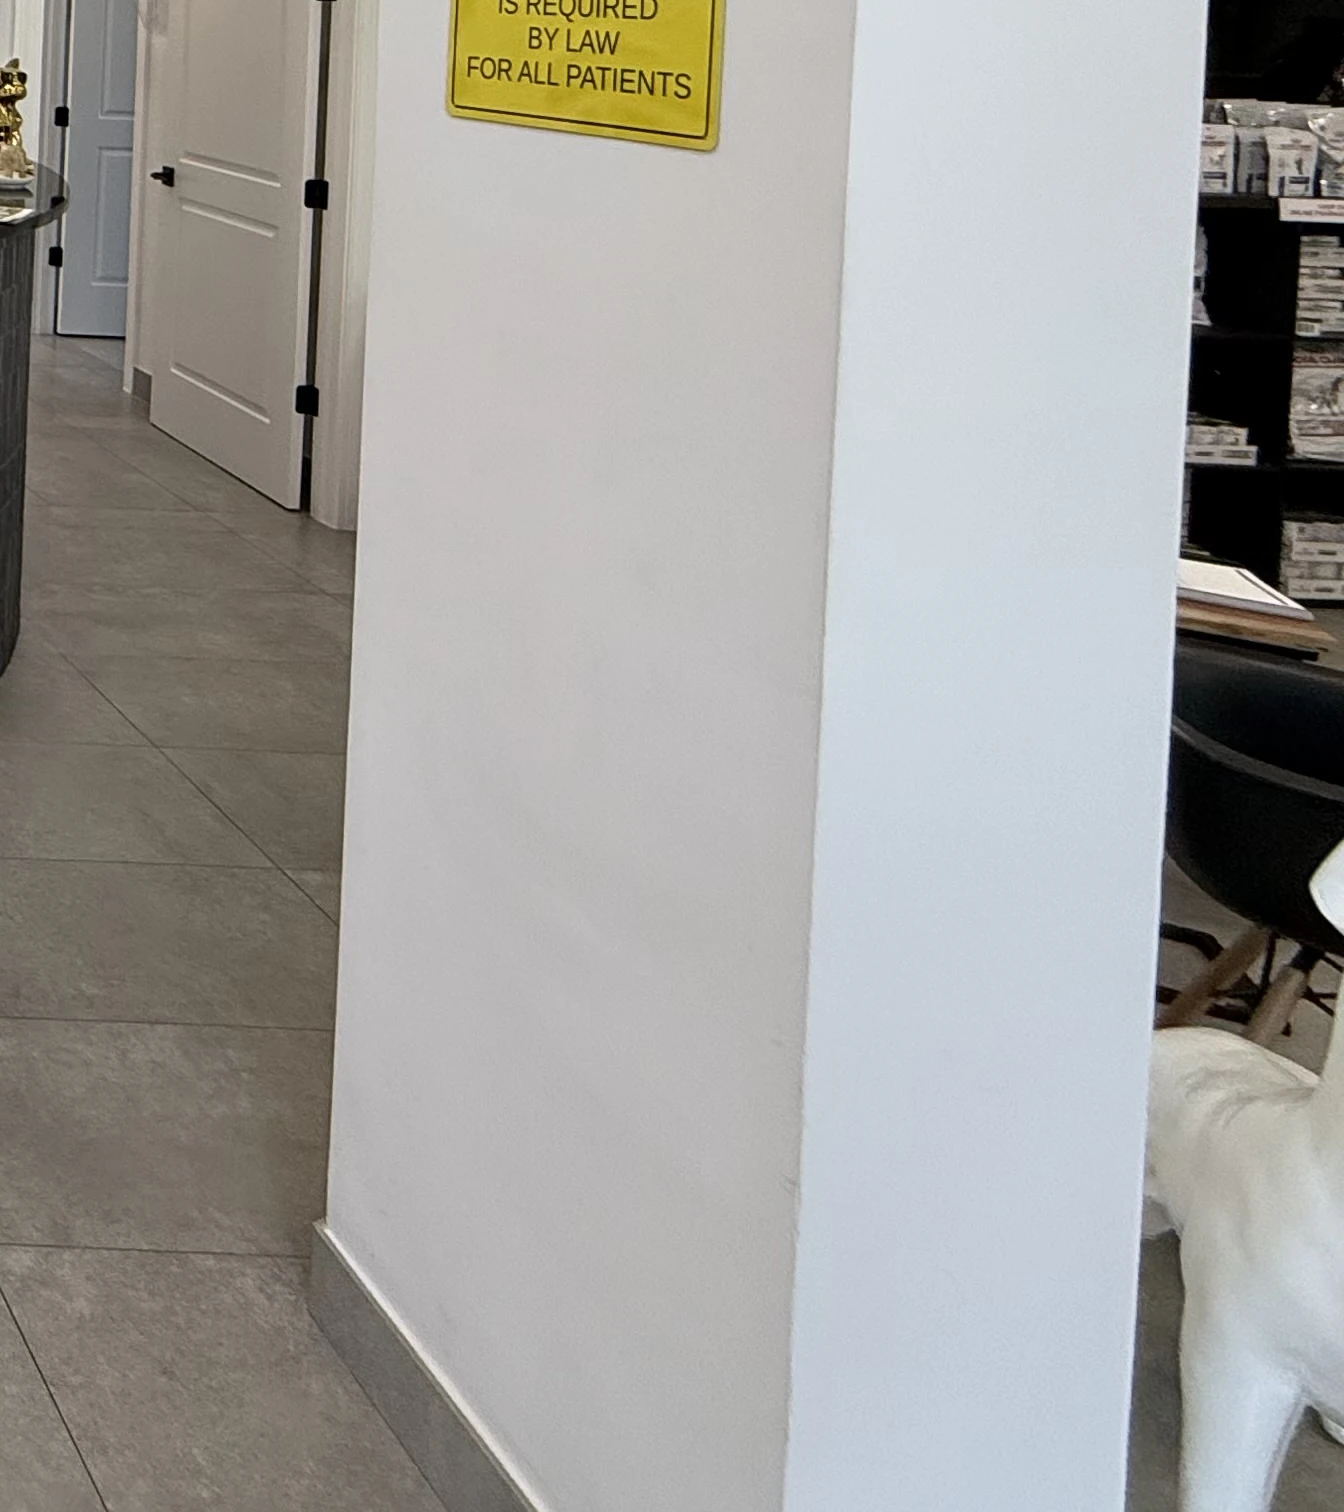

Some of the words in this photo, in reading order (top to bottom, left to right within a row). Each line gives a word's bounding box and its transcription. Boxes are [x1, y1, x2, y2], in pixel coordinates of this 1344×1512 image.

[528, 26, 559, 51] BY
[565, 28, 621, 55] LAW
[467, 56, 513, 82] FOR
[517, 60, 560, 87] ALL
[565, 63, 692, 100] PATIENTS
